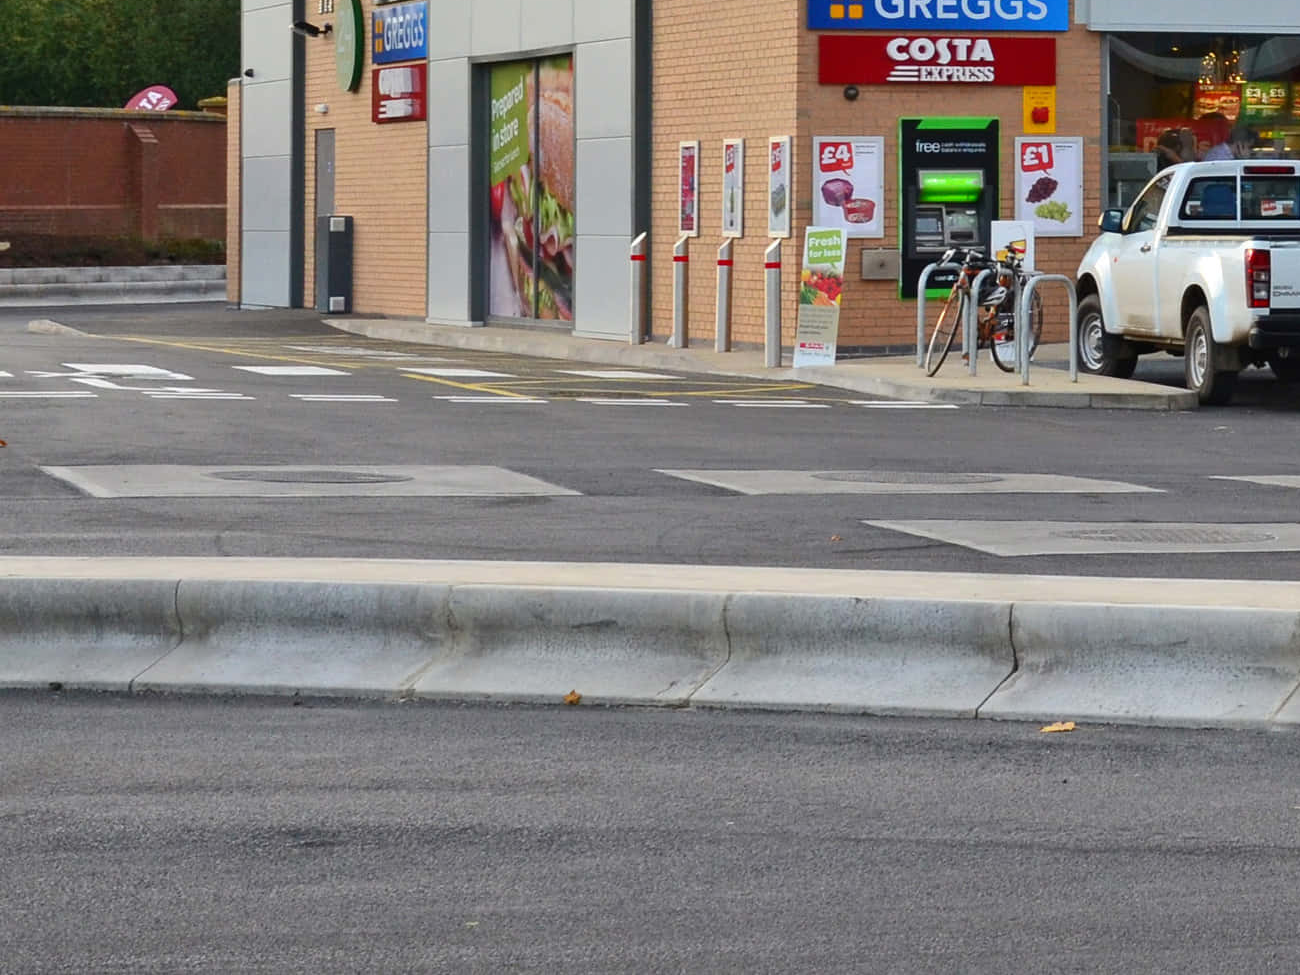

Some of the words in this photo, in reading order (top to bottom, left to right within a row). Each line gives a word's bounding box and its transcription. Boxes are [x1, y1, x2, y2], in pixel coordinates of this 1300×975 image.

[384, 13, 424, 52] GREGGS
[886, 37, 995, 64] COSTA
[919, 65, 995, 83] EXPRESS
[491, 75, 523, 121] Prepared
[500, 118, 519, 147] store
[821, 145, 851, 164] £4
[916, 139, 940, 153] free
[1023, 145, 1050, 166] £1
[809, 235, 841, 247] Fresh
